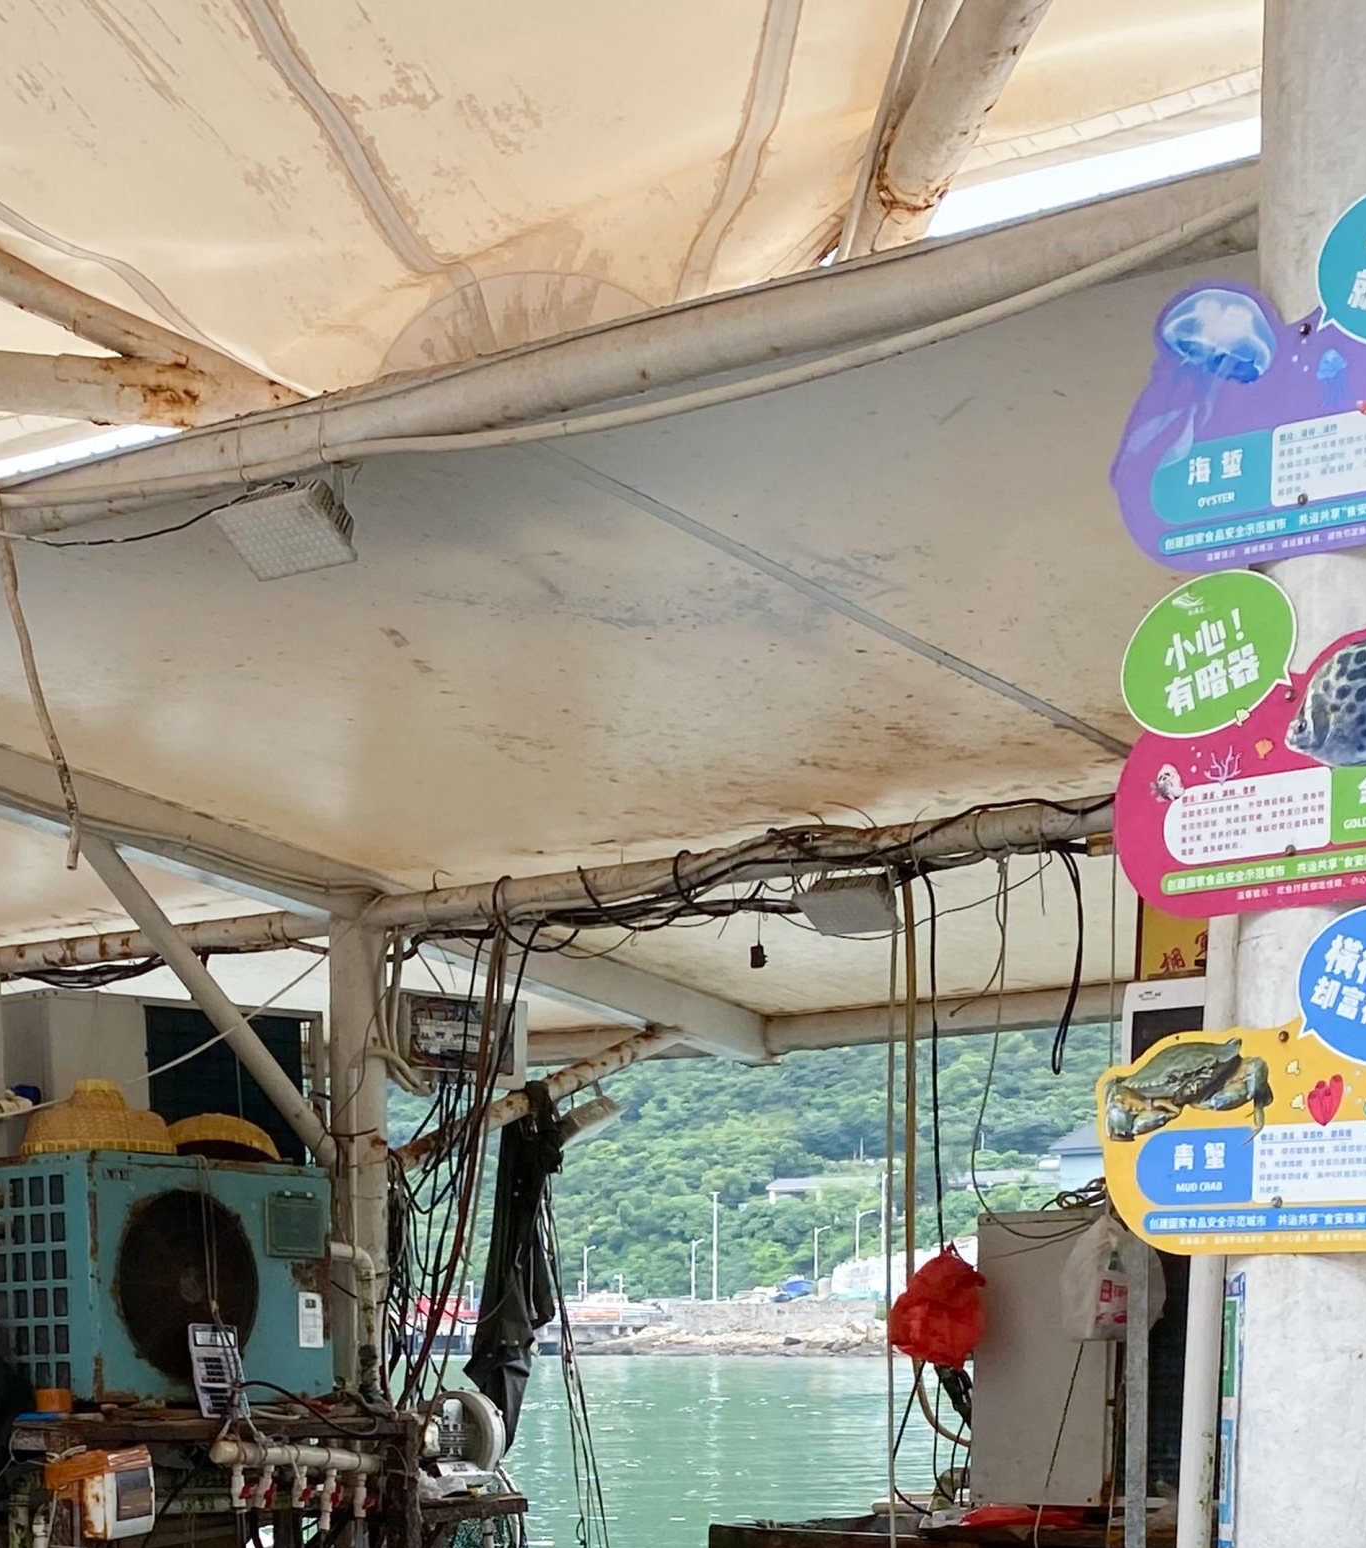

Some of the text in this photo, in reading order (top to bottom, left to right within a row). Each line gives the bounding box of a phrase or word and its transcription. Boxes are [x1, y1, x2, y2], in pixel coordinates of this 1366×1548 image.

[1197, 491, 1236, 509] OYSTER
[1163, 643, 1261, 718] 有暗器
[1171, 1140, 1229, 1174] 青蟹
[1174, 1180, 1224, 1194] MUD CRAB
